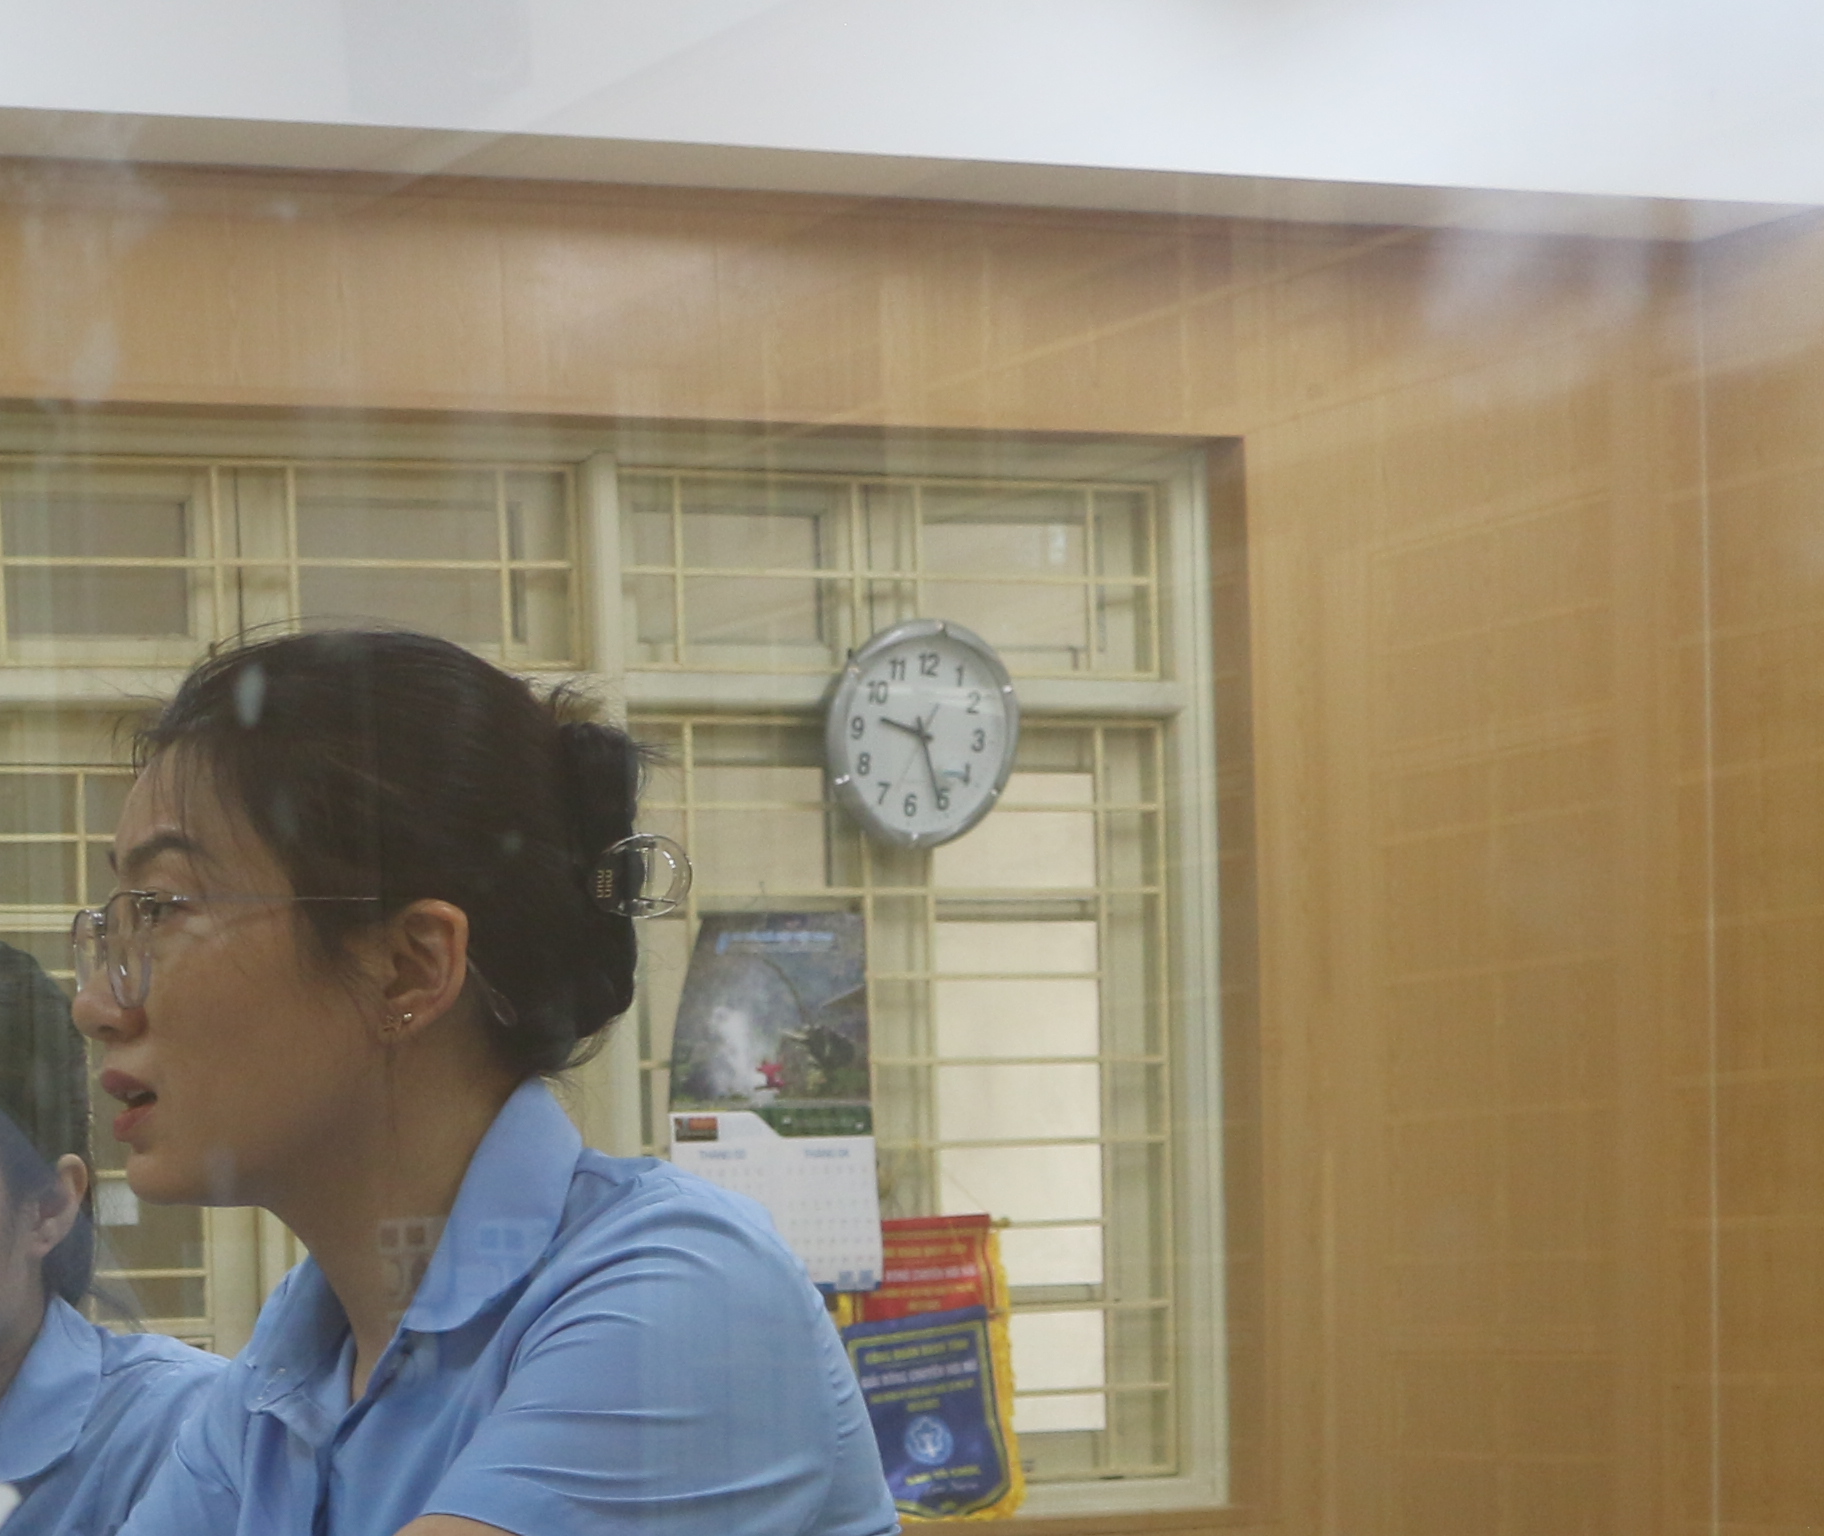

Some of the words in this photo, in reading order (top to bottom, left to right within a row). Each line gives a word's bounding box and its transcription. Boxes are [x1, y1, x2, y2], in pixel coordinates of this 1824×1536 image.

[889, 659, 907, 681] 11
[919, 653, 940, 677] 12
[956, 665, 964, 687] 1
[867, 680, 889, 705] 10
[966, 691, 981, 714] 2
[852, 716, 865, 740] 9
[971, 728, 985, 752] 3
[857, 752, 871, 776] 8
[877, 781, 891, 805] 7
[904, 793, 918, 817] 6
